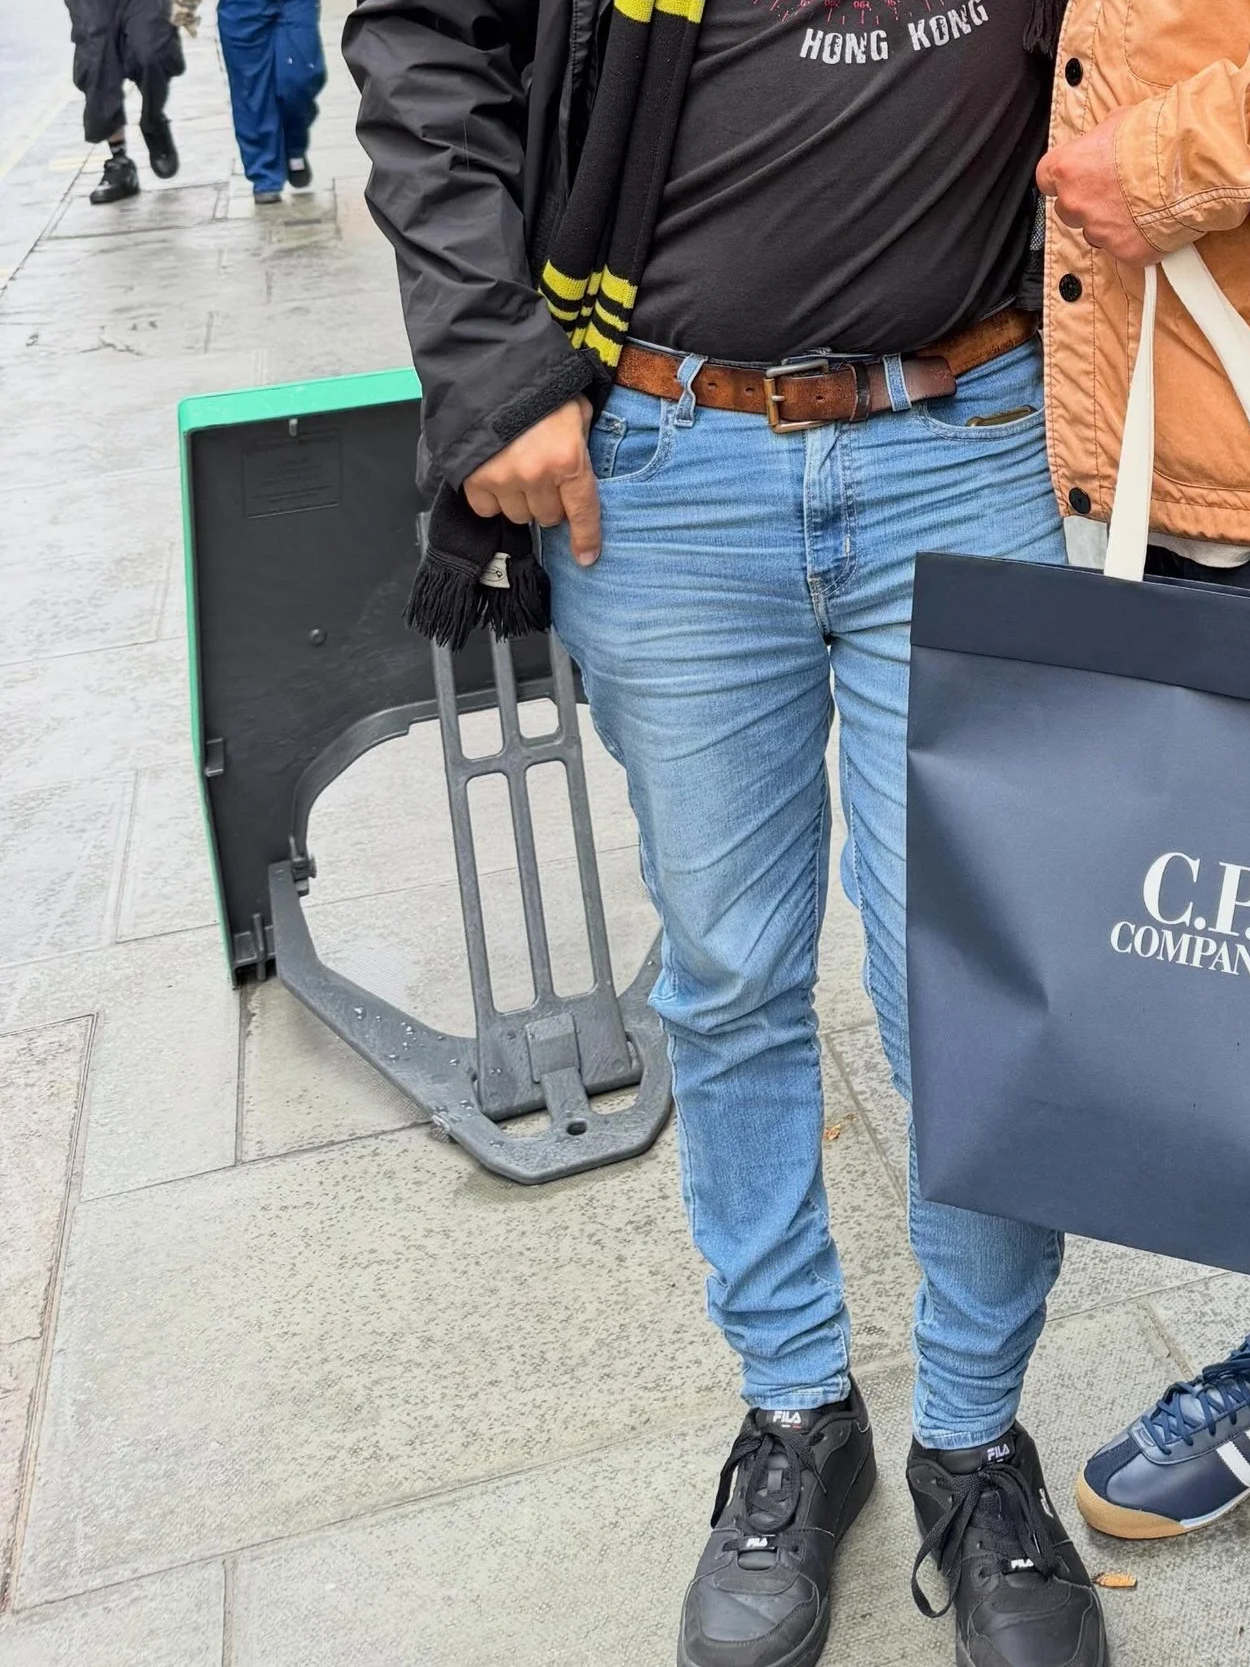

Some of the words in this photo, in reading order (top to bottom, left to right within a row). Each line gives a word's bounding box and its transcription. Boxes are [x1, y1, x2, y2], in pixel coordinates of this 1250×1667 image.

[799, 27, 889, 65] HONG
[772, 1410, 802, 1424] FILA
[986, 1443, 1011, 1462] FILA
[1010, 1558, 1035, 1570] FILA
